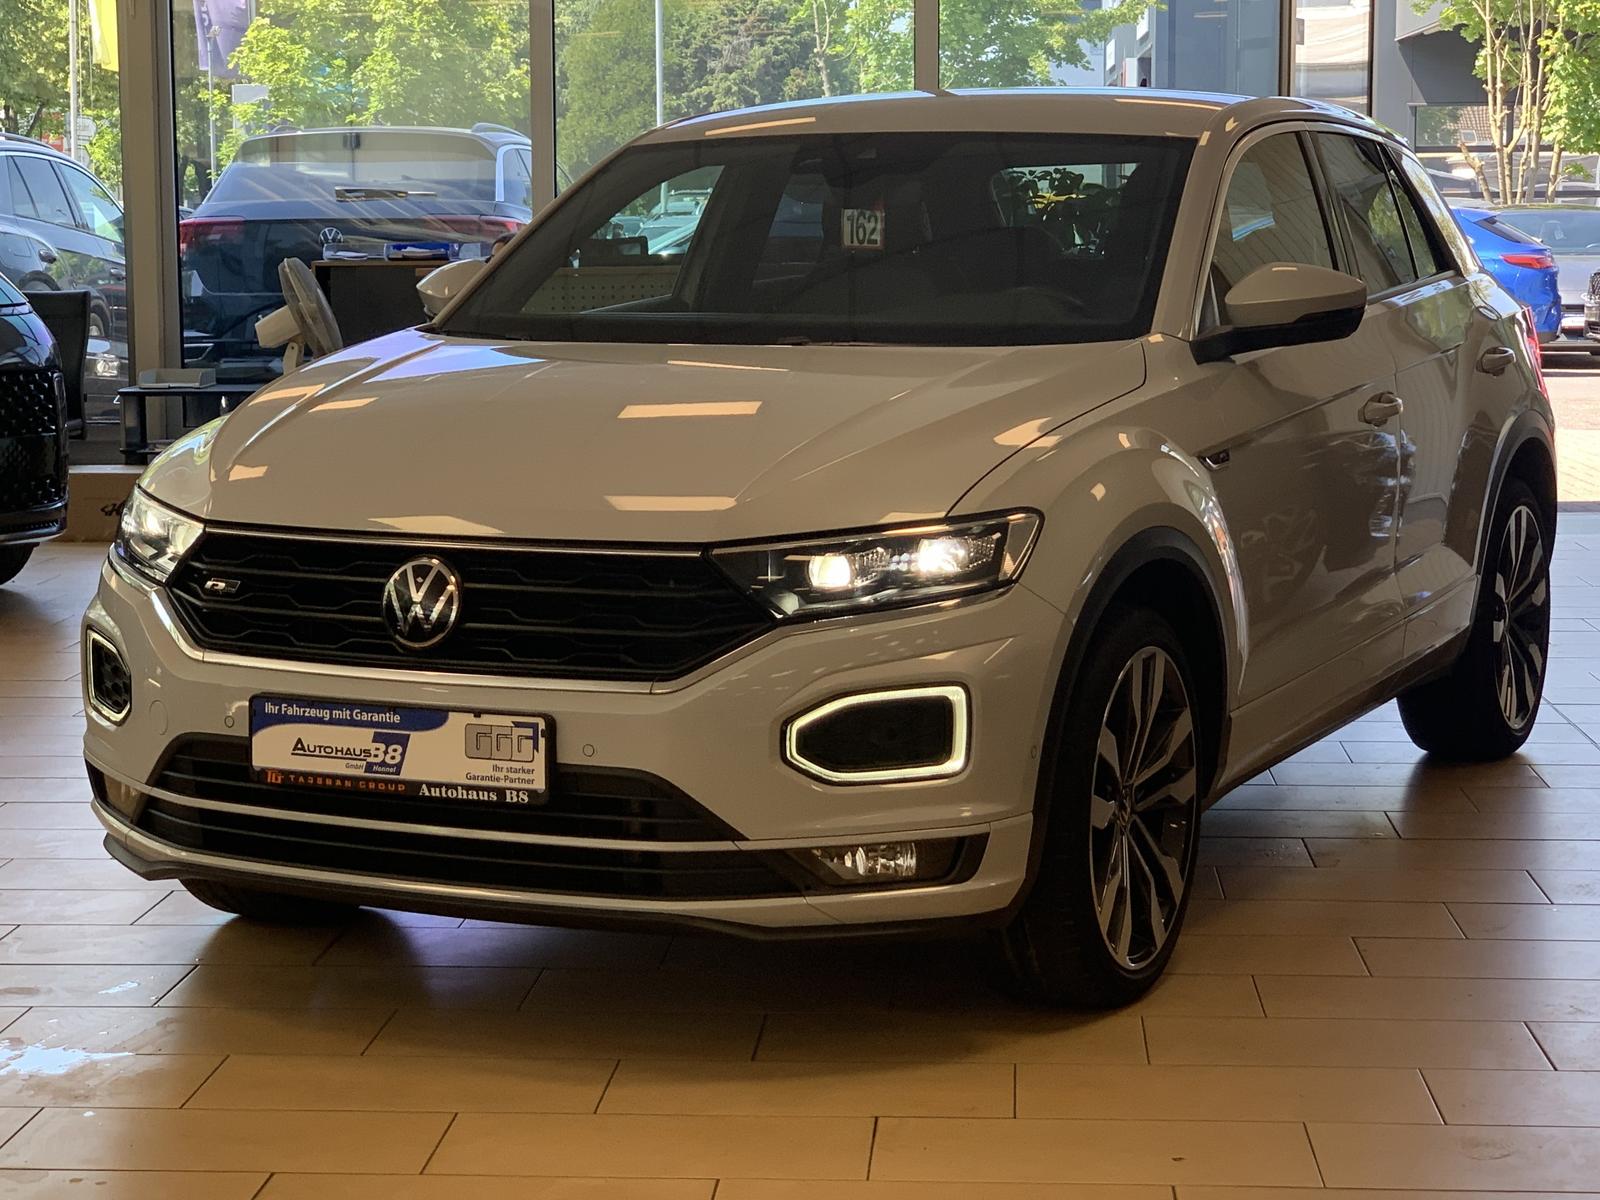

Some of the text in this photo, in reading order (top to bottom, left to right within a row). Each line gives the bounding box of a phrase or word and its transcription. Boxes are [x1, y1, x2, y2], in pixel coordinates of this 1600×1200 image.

[846, 210, 879, 245] 162
[265, 702, 401, 723] Ihr Fahrzeug mit Garantie
[345, 762, 364, 770] GmbH
[492, 764, 535, 775] Ihr starker
[465, 772, 535, 785] Garantie-Partner
[359, 780, 406, 792] GROUP
[419, 783, 529, 804] Autohaus B8
